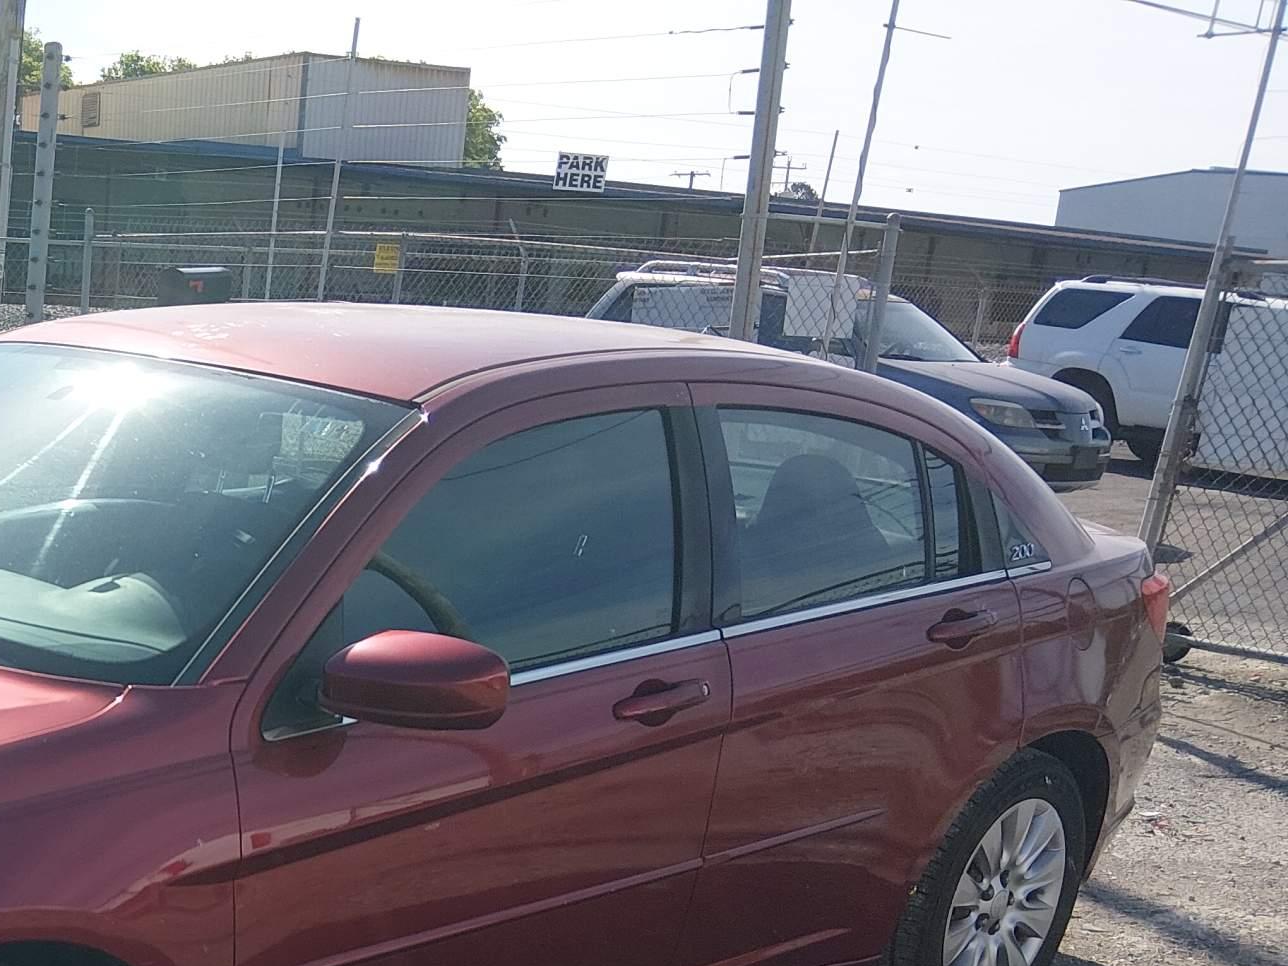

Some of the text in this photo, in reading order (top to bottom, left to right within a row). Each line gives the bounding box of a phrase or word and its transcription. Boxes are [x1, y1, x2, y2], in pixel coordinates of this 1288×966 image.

[557, 154, 607, 172] PARK
[555, 172, 604, 189] HERE
[1010, 542, 1035, 561] 200
